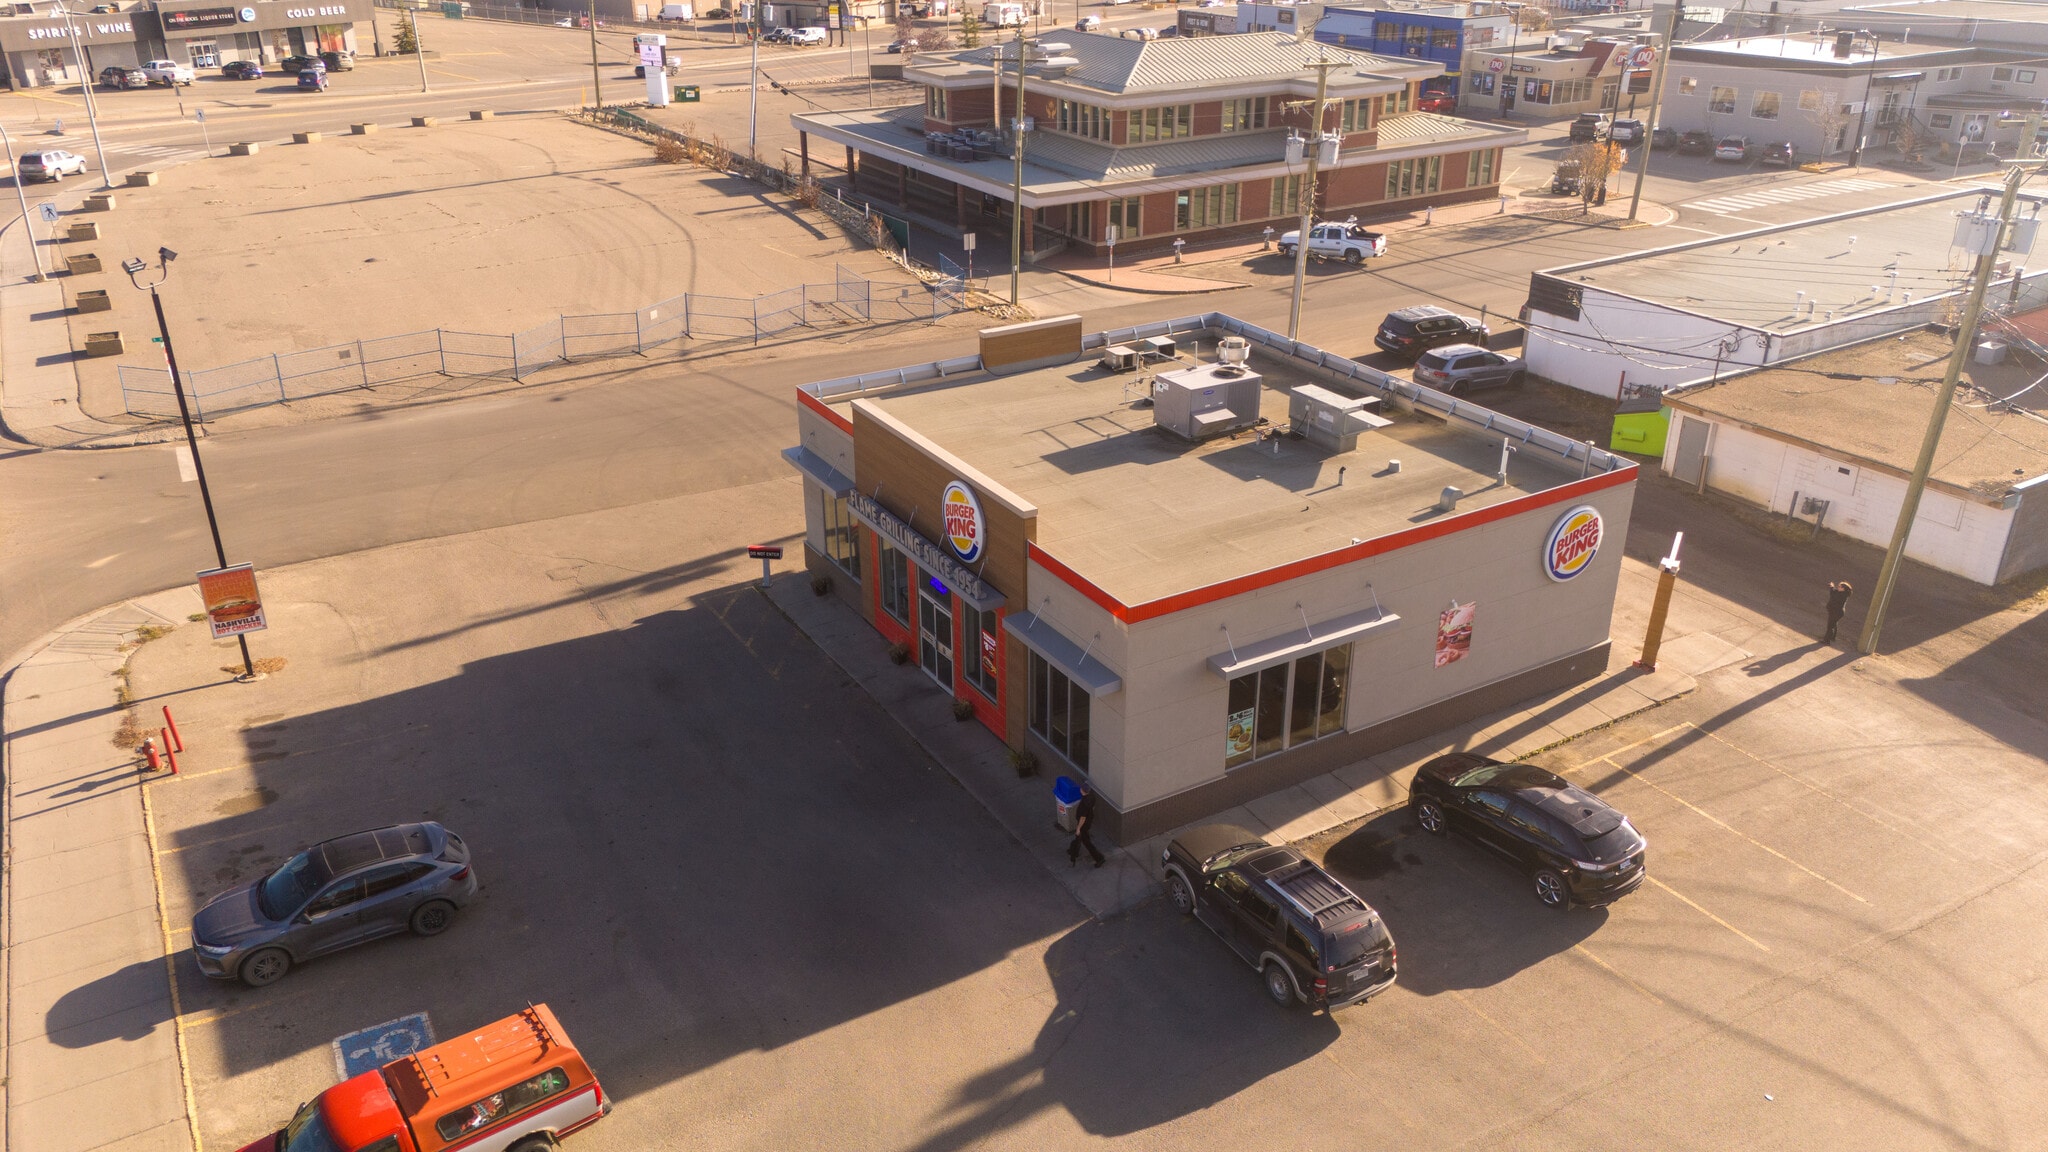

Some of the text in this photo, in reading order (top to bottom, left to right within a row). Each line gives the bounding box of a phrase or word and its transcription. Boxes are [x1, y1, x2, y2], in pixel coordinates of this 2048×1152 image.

[286, 5, 346, 19] COLD BEER
[28, 22, 133, 40] SPIRITS WINE
[1491, 60, 1503, 70] DQ
[1636, 51, 1653, 63] DQ
[945, 503, 975, 520] BURGER
[946, 517, 976, 539] KING
[1556, 516, 1599, 554] BURGER
[850, 488, 878, 523] FLAME
[880, 511, 921, 556] GRILLING
[923, 543, 952, 580] SINCE
[953, 566, 983, 600] 1954
[1554, 528, 1599, 571] KING
[214, 615, 261, 630] NASHVILLE
[216, 621, 262, 635] HOT CHICKEN
